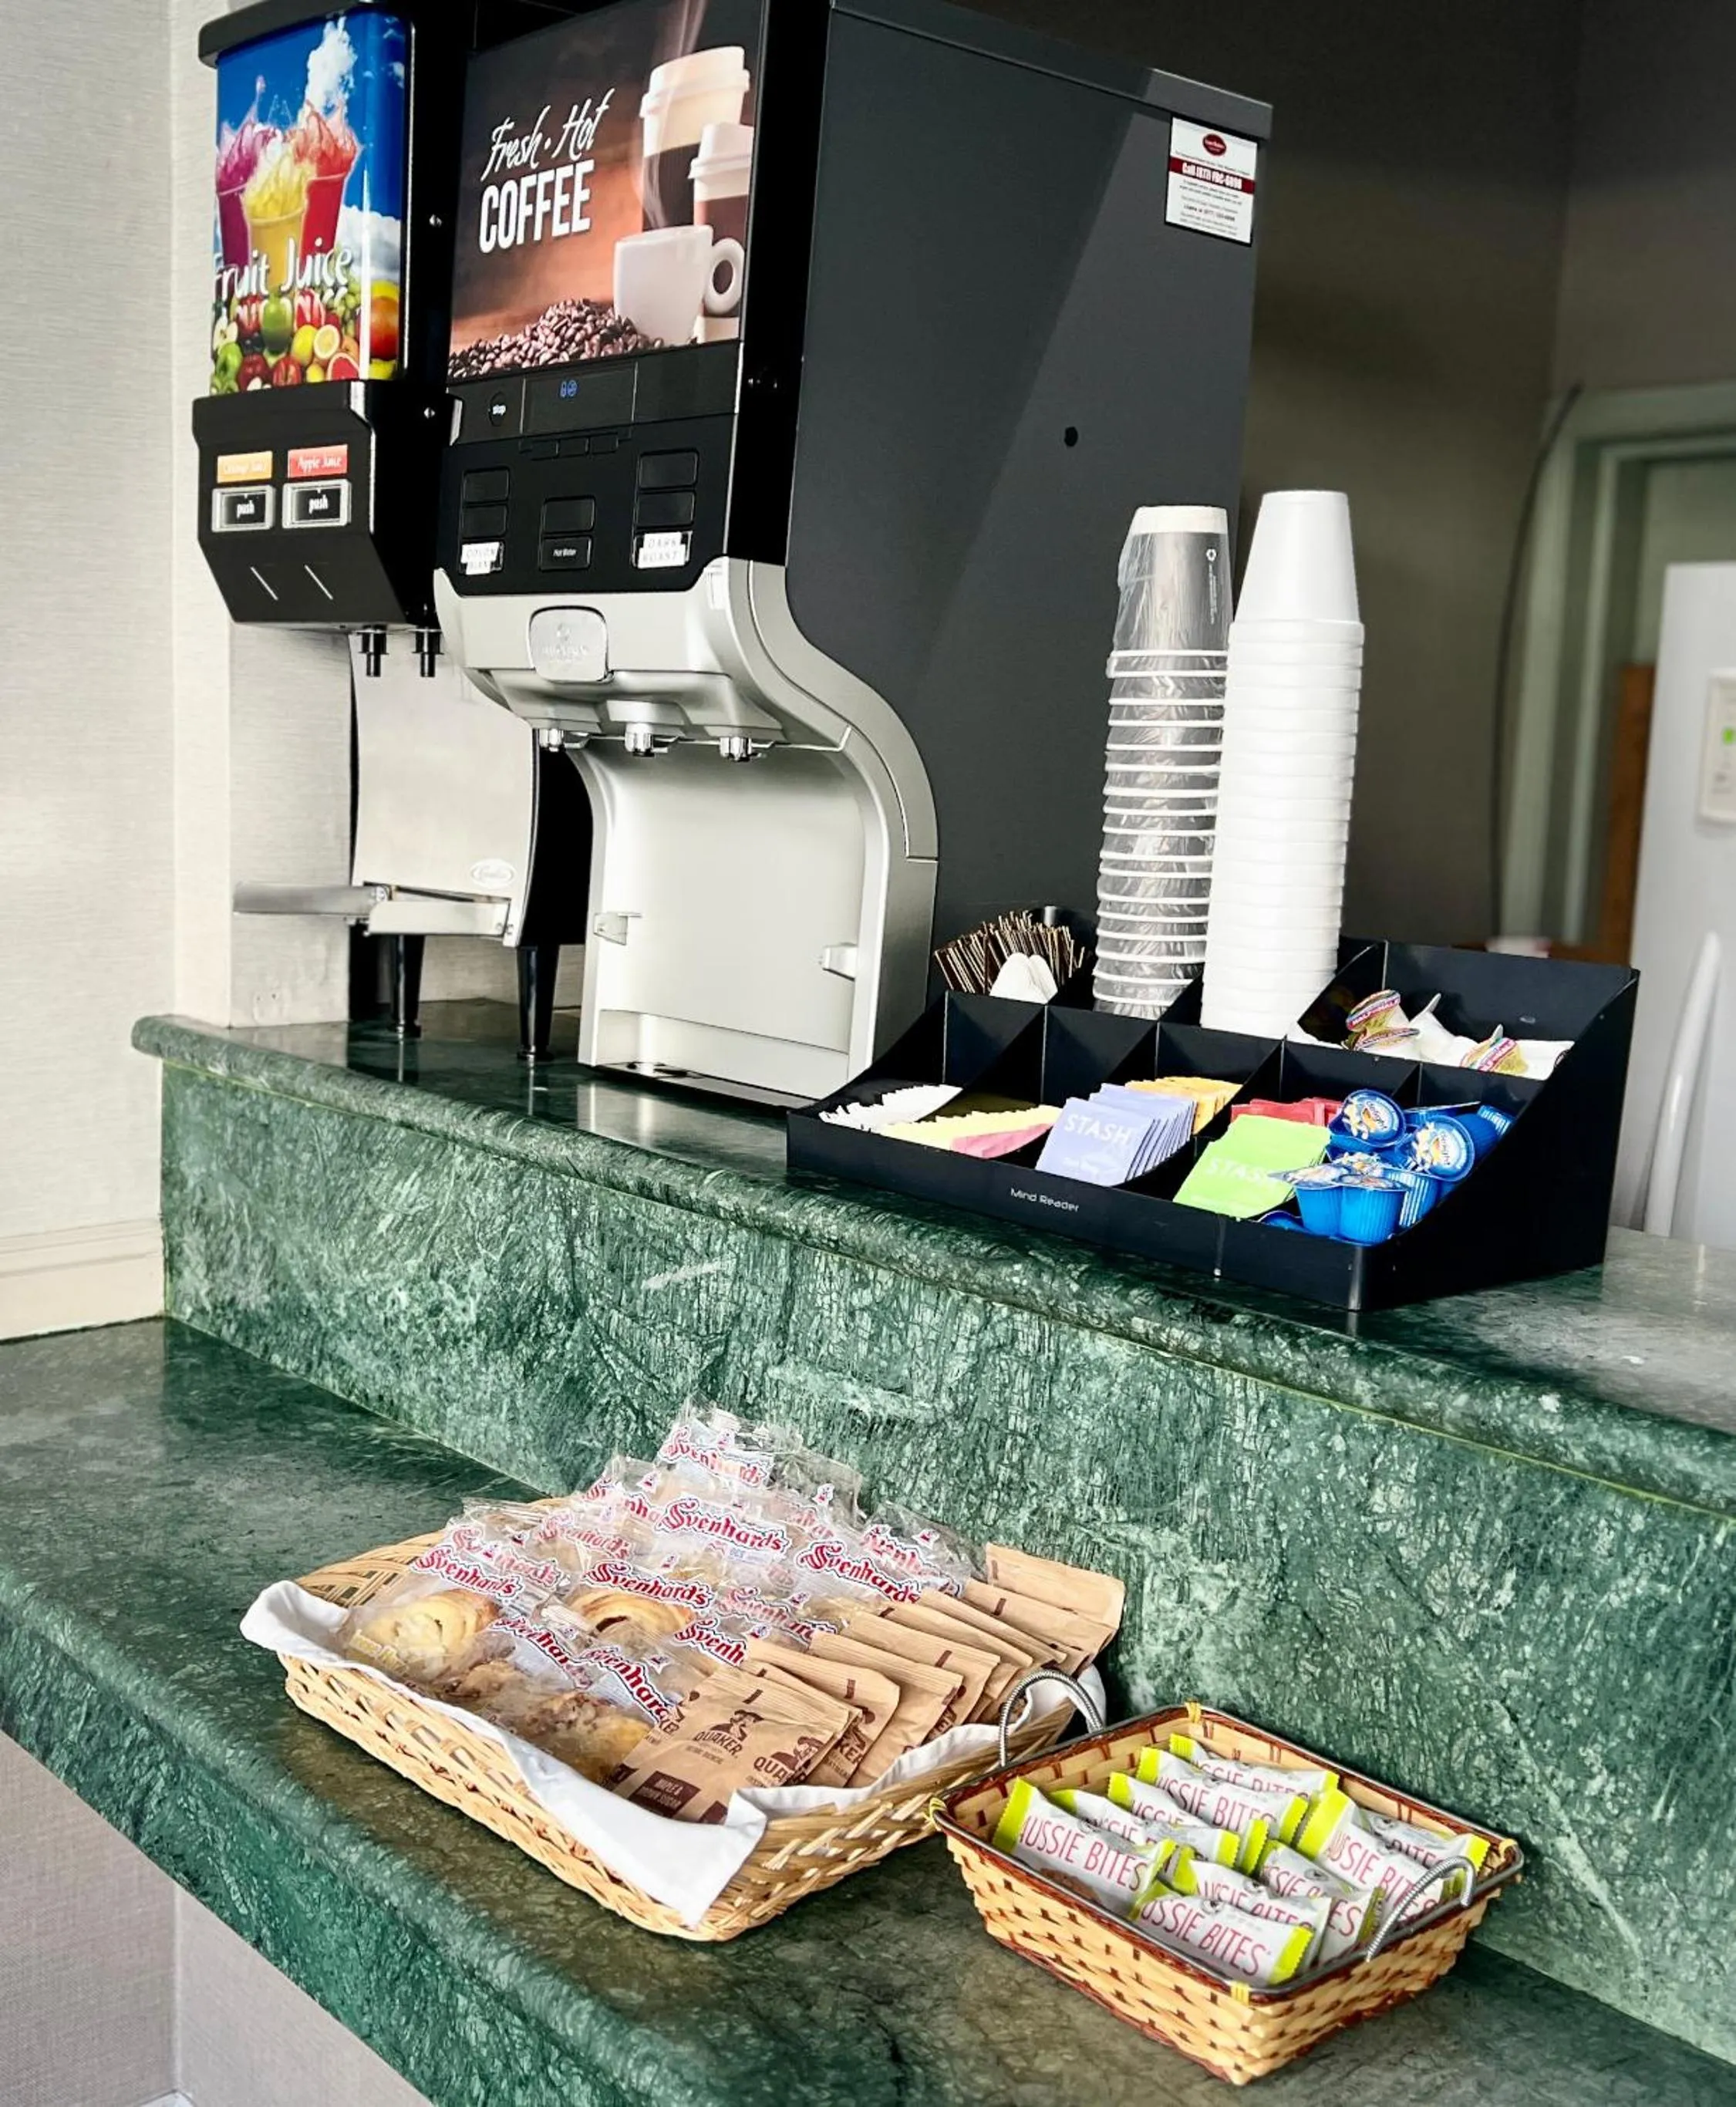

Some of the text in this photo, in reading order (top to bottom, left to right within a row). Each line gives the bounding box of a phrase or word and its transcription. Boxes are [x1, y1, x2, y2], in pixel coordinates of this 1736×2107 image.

[480, 88, 615, 181] Fresh Hot
[479, 159, 595, 253] COFFEE
[281, 238, 352, 292] Juice
[237, 500, 255, 519] push
[308, 494, 328, 514] push
[1064, 1114, 1133, 1147] STASH
[1010, 1187, 1079, 1212] Mind Reader
[662, 1500, 784, 1552] Svenhard's
[416, 1548, 517, 1595] Svenhard's
[583, 1562, 711, 1606] Svenhard's
[693, 1731, 743, 1756] QUAKER
[1084, 1841, 1150, 1892] BITES
[1198, 1923, 1267, 1976] BITES
